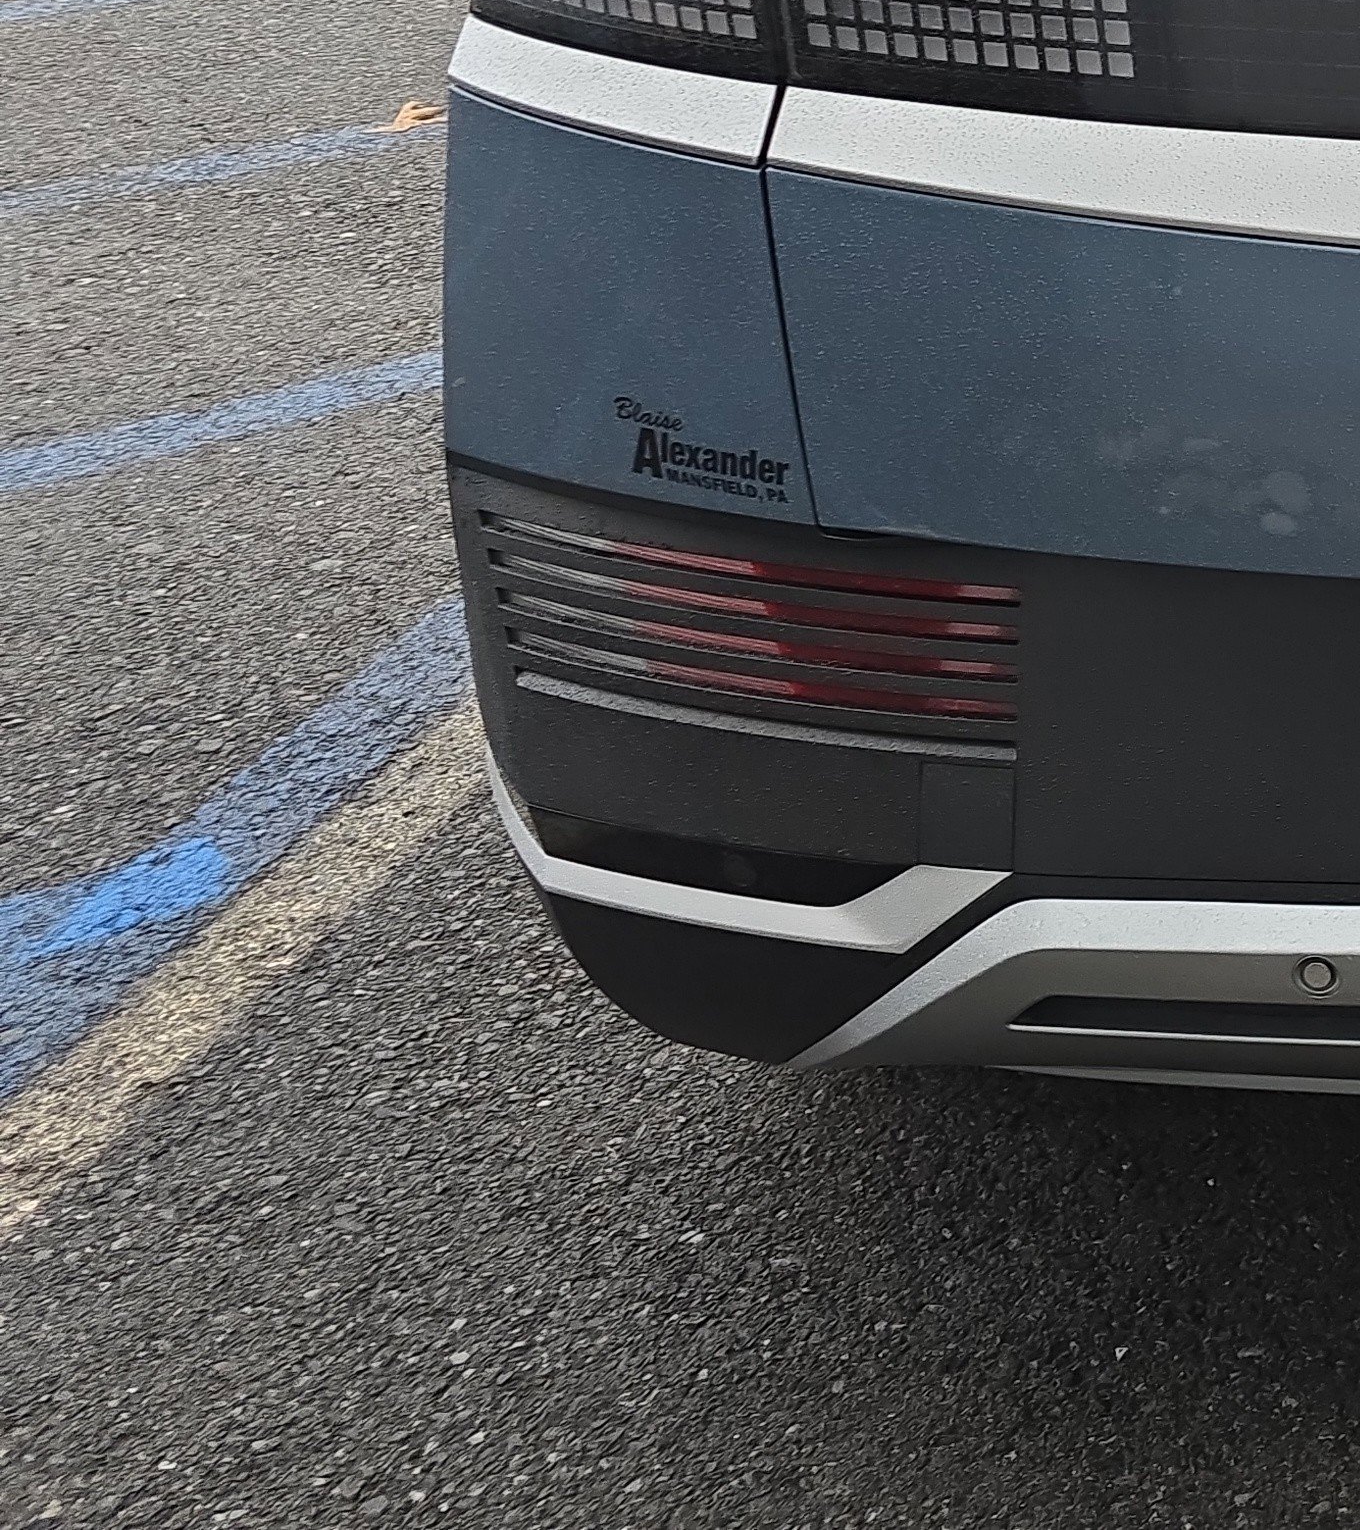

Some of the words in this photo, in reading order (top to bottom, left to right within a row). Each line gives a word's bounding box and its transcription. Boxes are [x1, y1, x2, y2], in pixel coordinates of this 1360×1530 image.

[613, 396, 683, 432] Blaise
[630, 427, 790, 485] Alexander
[665, 468, 763, 503] MANSFIELD,
[766, 487, 790, 504] PA
